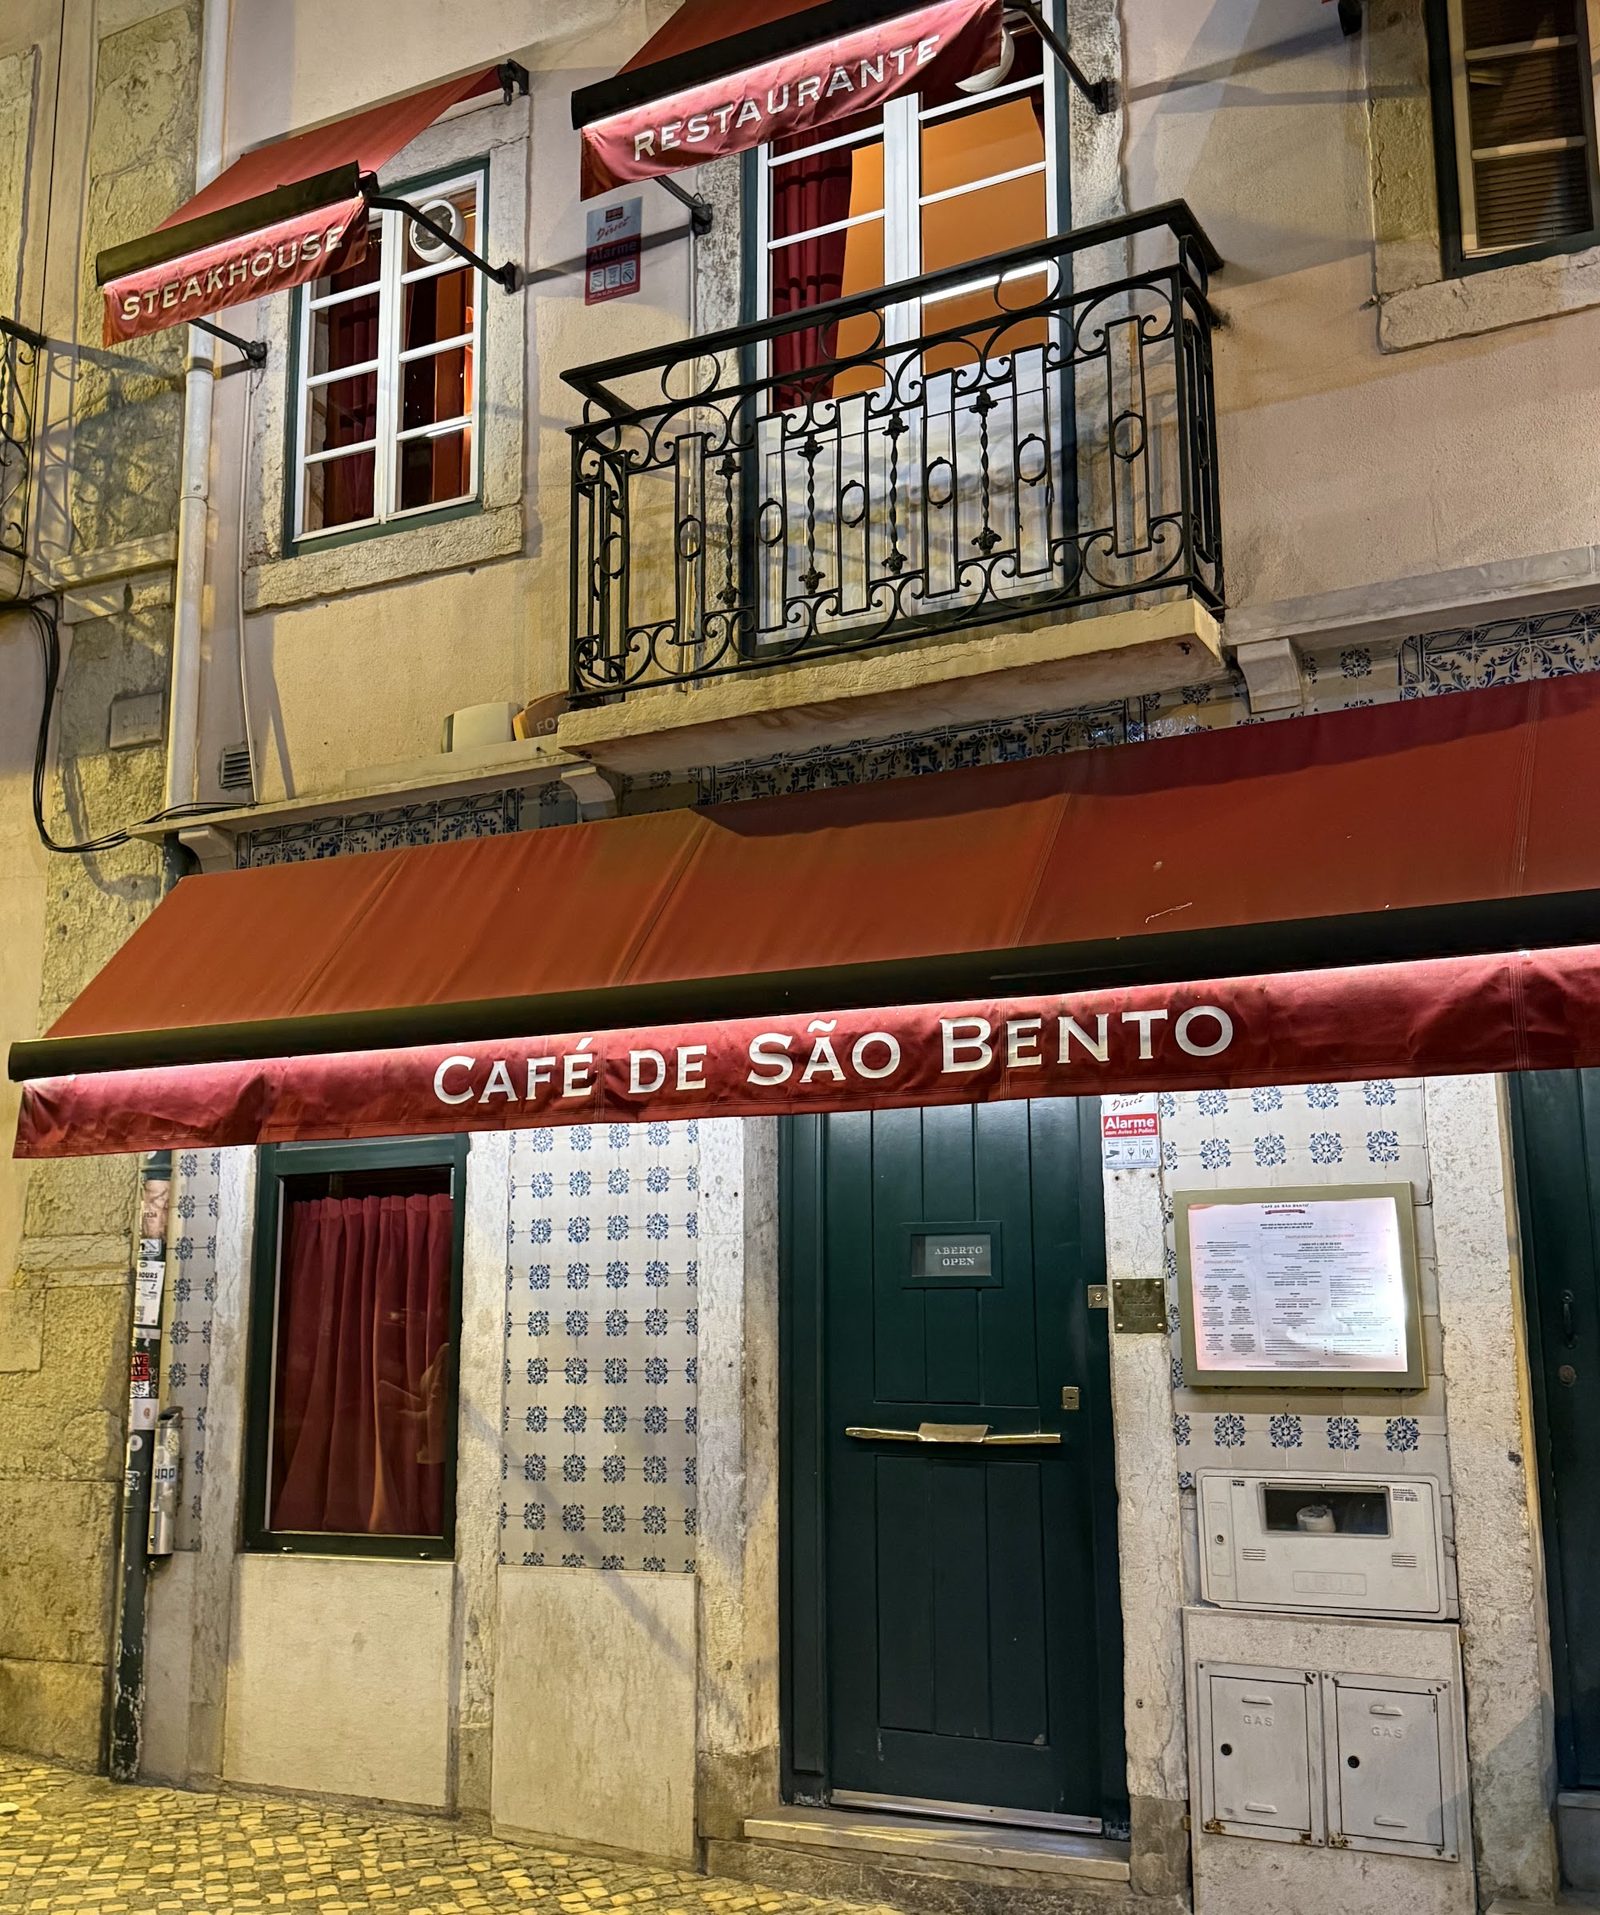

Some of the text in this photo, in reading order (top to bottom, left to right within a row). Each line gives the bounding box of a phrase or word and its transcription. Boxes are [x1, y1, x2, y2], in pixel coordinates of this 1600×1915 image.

[634, 34, 940, 162] RESTAURANTE
[590, 241, 637, 263] Alarme
[120, 225, 345, 321] STEAKHOUSE
[433, 1005, 1235, 1105] CAFÉ DE SÃO BENTO
[1105, 1116, 1155, 1130] Alarme
[934, 1246, 983, 1255] ABERTO
[942, 1258, 975, 1266] OPEN
[1242, 1714, 1274, 1728] GAS
[1371, 1725, 1404, 1740] GAS
